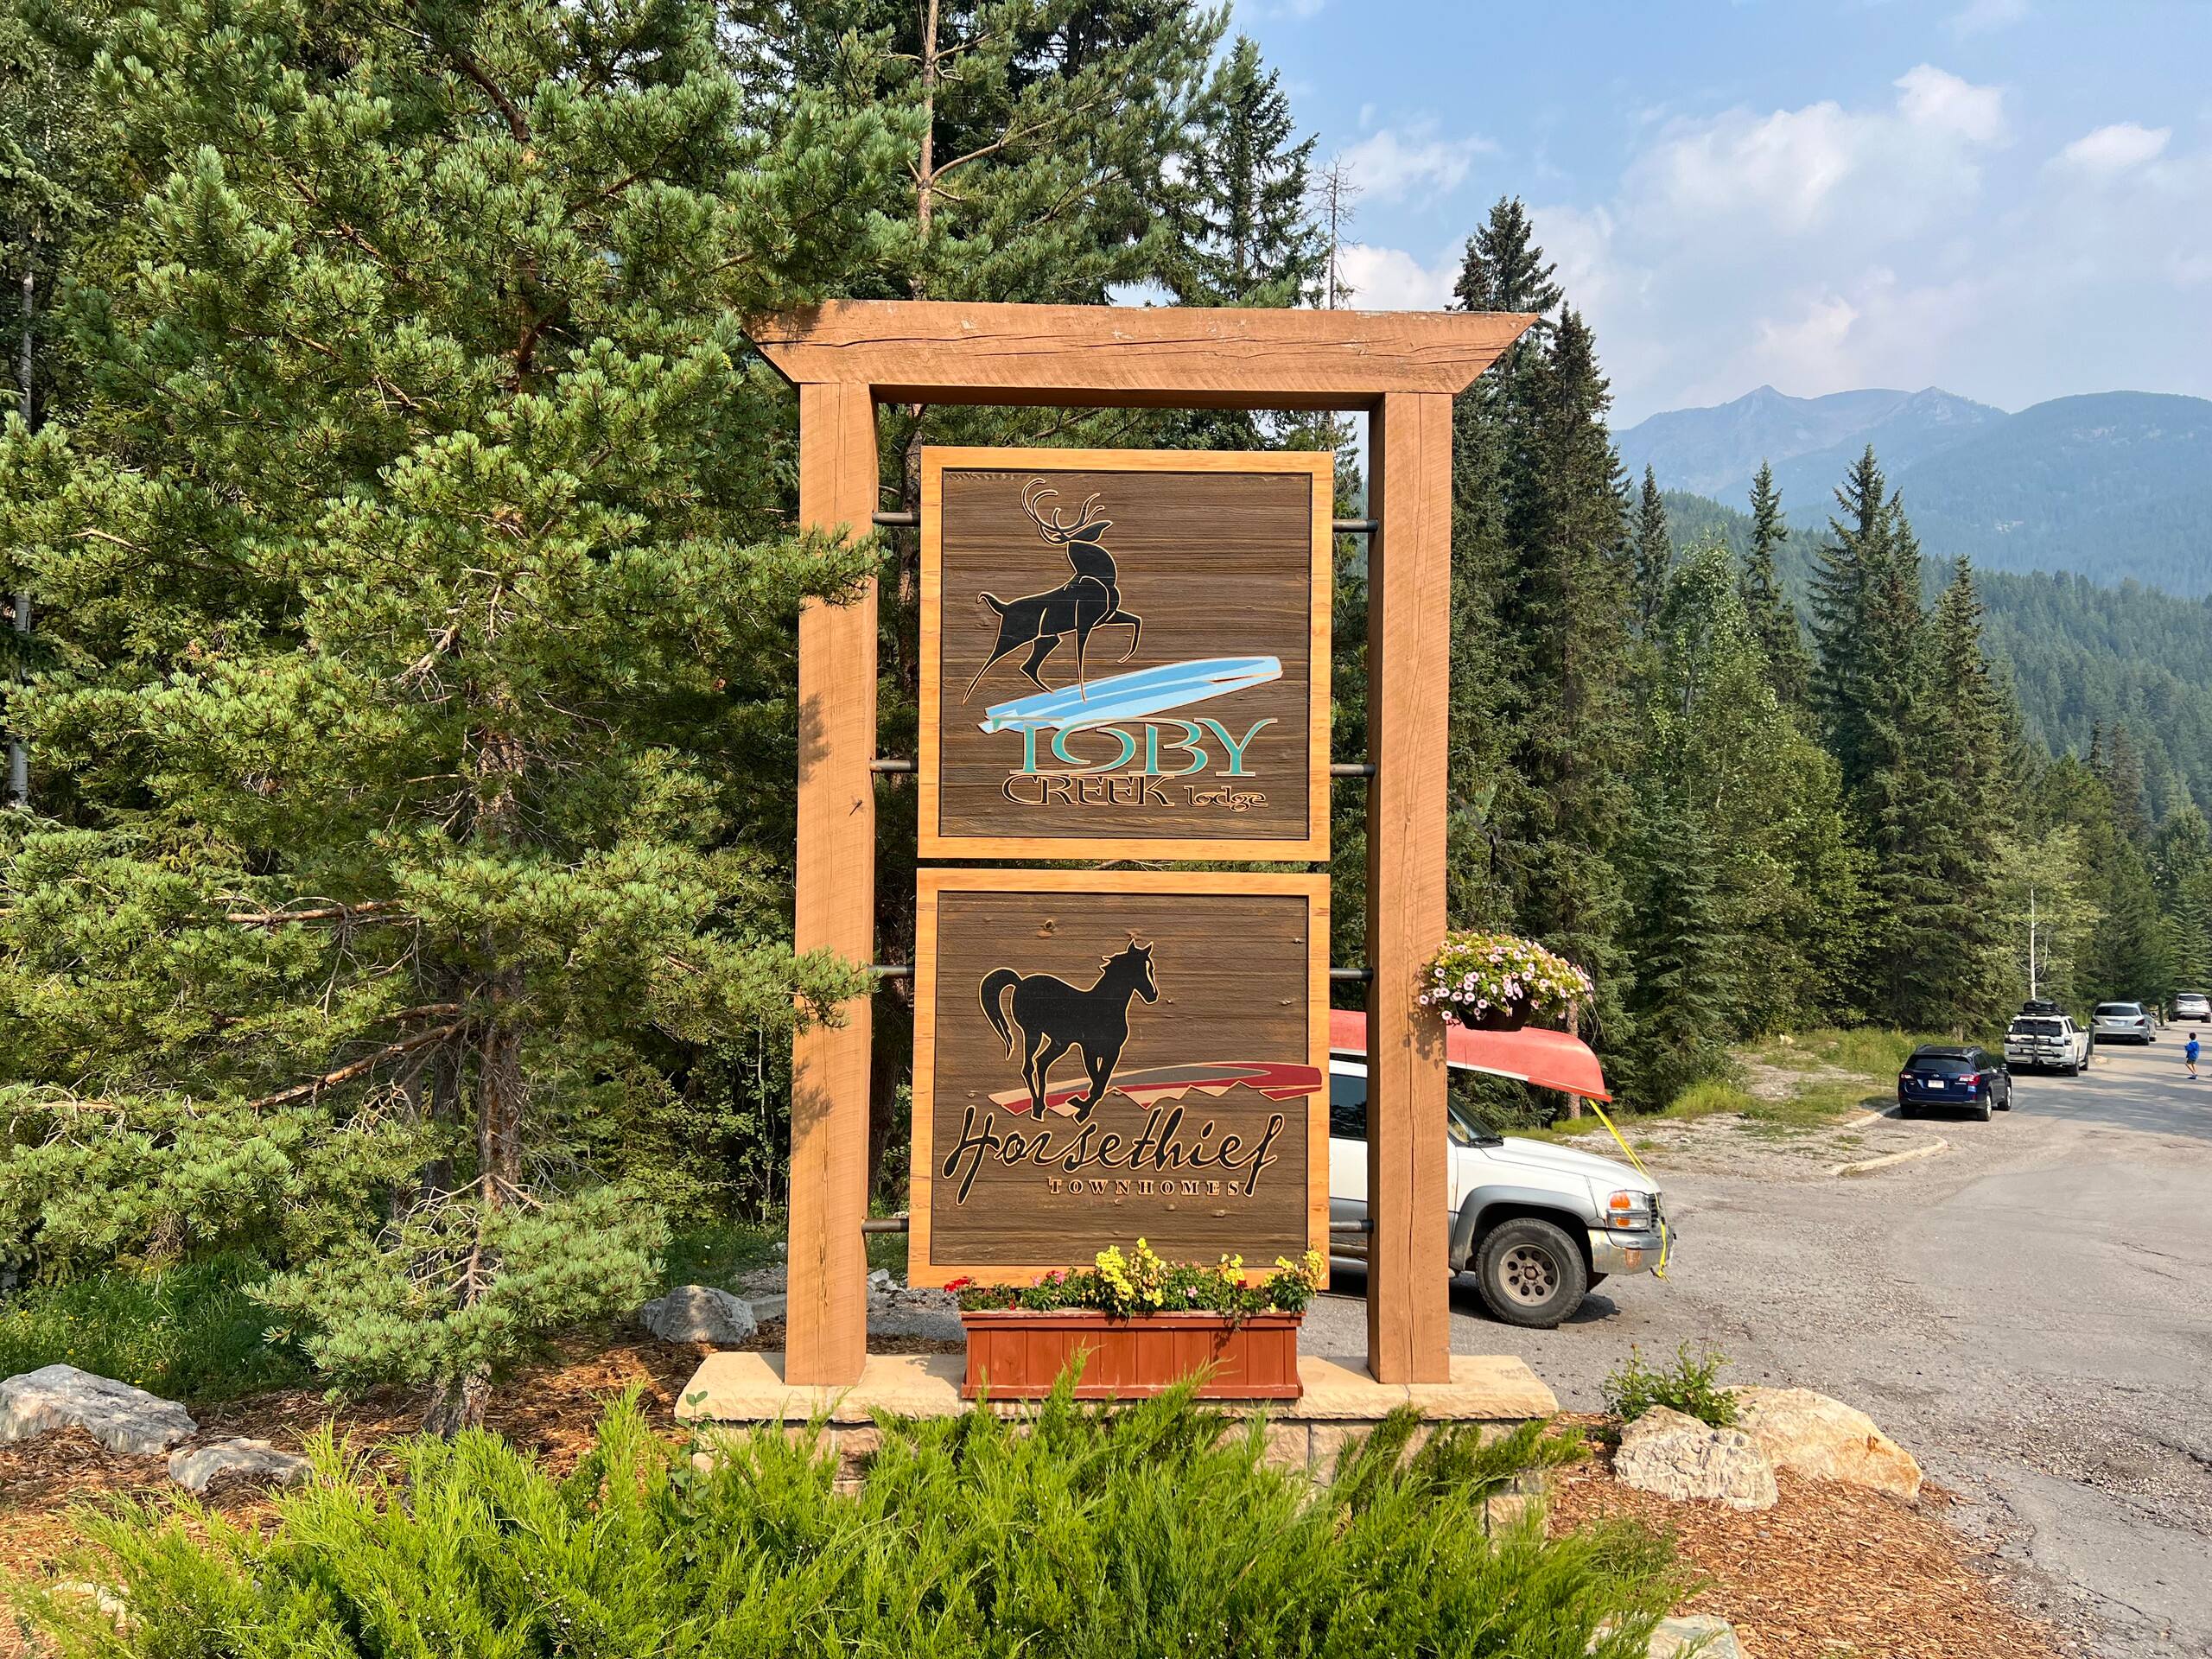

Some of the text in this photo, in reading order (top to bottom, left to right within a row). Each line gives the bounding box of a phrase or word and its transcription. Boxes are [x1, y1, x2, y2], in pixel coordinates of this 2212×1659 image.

[991, 716, 1278, 777] TOBY
[1001, 774, 1268, 812] CREEK lodge
[942, 1106, 1284, 1205] Horsethief
[1047, 1176, 1241, 1196] TOWNHOMES
